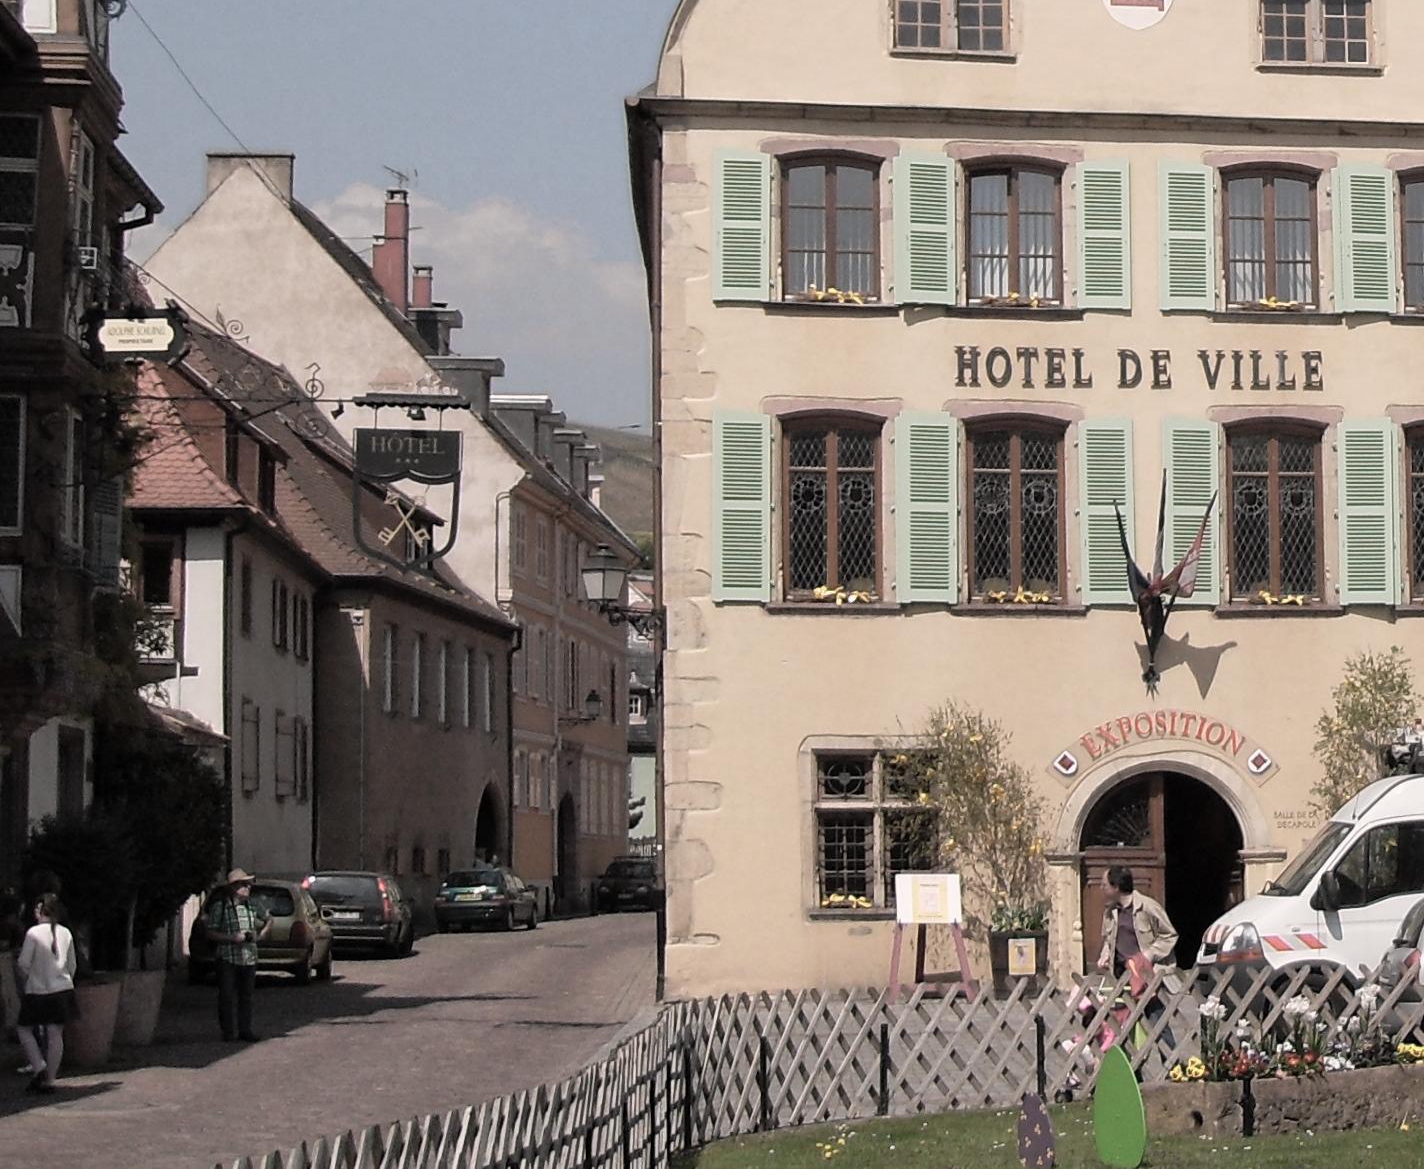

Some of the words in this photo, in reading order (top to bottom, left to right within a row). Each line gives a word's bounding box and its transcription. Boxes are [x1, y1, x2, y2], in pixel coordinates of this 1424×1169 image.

[954, 345, 1094, 389] HOTEL
[1116, 348, 1173, 390] DE
[1196, 349, 1325, 392] VILLE
[370, 430, 446, 455] HÔTEL
[1079, 709, 1246, 761] EXPOSITION
